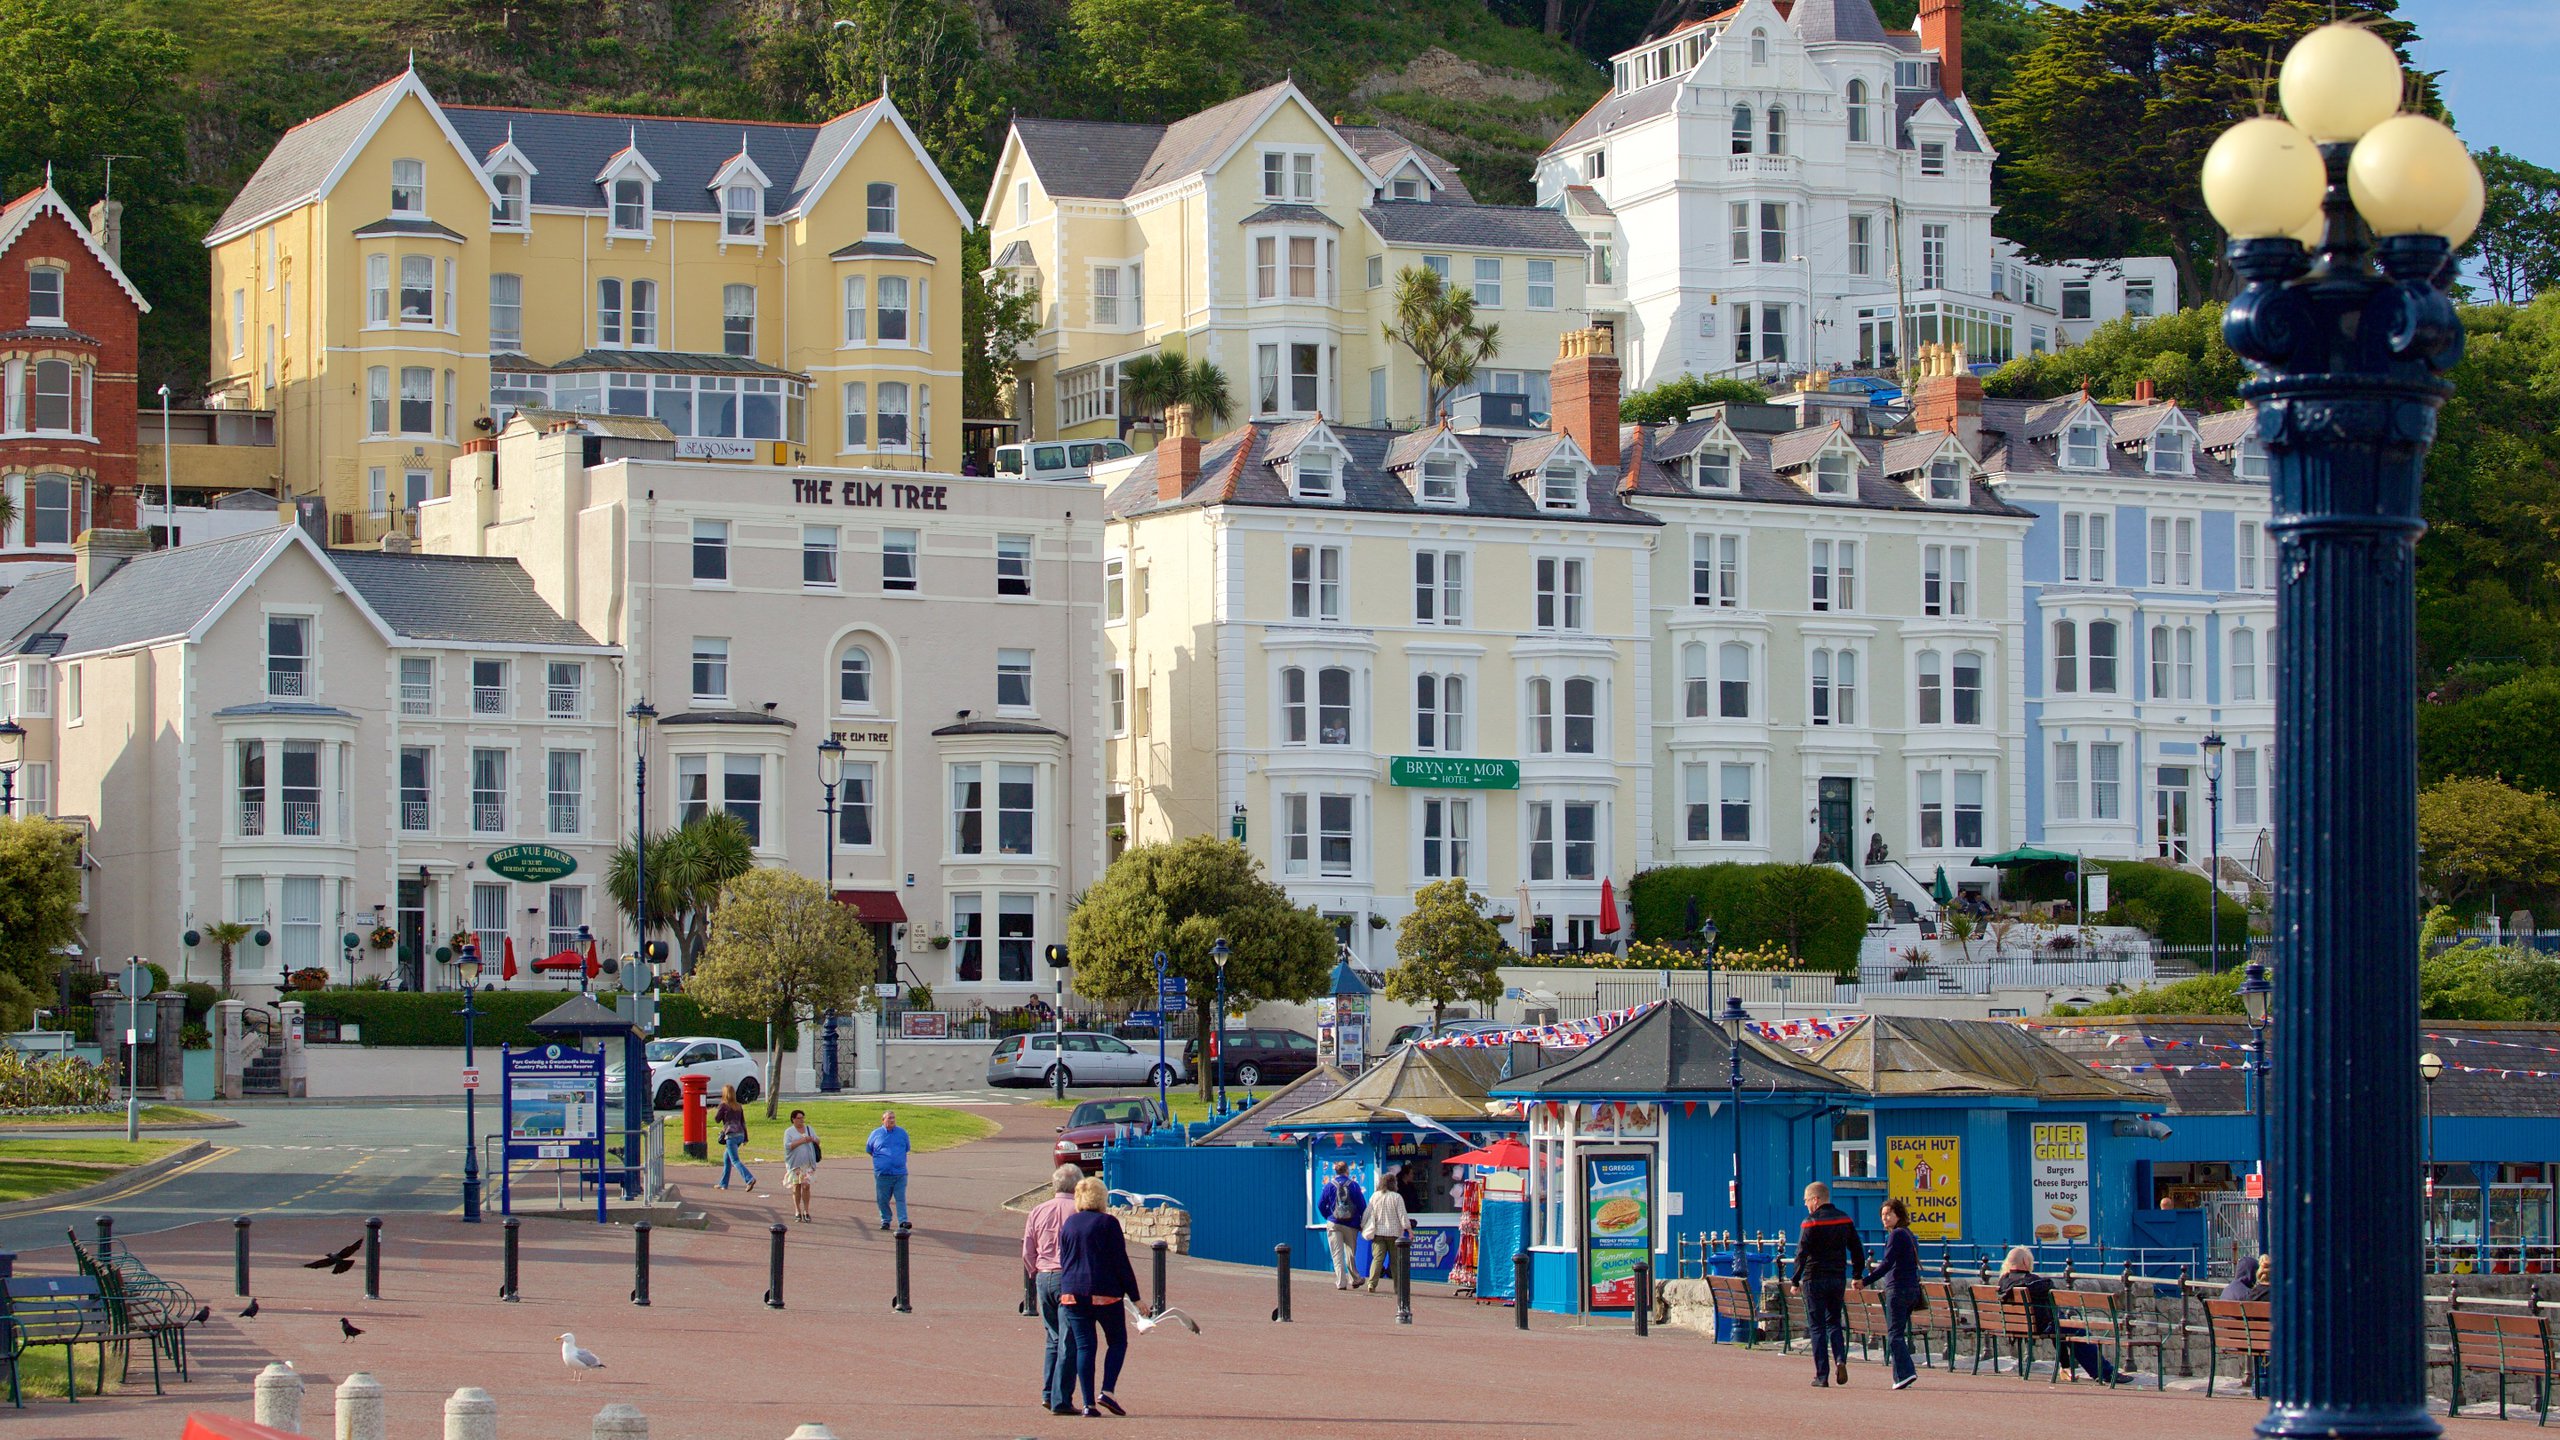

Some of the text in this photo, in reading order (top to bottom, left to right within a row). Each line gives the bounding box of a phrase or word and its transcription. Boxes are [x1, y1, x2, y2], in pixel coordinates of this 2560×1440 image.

[684, 442, 735, 456] SEASONS
[793, 479, 948, 510] THE ELM TREE
[832, 732, 888, 742] THE ELM TREE
[1406, 761, 1504, 776] BRYN Y MOR
[1442, 776, 1469, 784] HOTEL
[493, 846, 571, 865] BELLE VUE HOUSE
[2034, 1126, 2086, 1144] PIER
[1890, 1139, 1956, 1150] BEACH HUT
[2034, 1144, 2086, 1161] GRILL
[2047, 1166, 2074, 1176] Burgers
[2034, 1178, 2088, 1188] Cheese Burgers
[1895, 1196, 1957, 1207] LL THINGS
[2044, 1192, 2078, 1202] Hot Dogs
[1908, 1212, 1946, 1222] EACH
[1595, 1250, 1633, 1267] Summer
